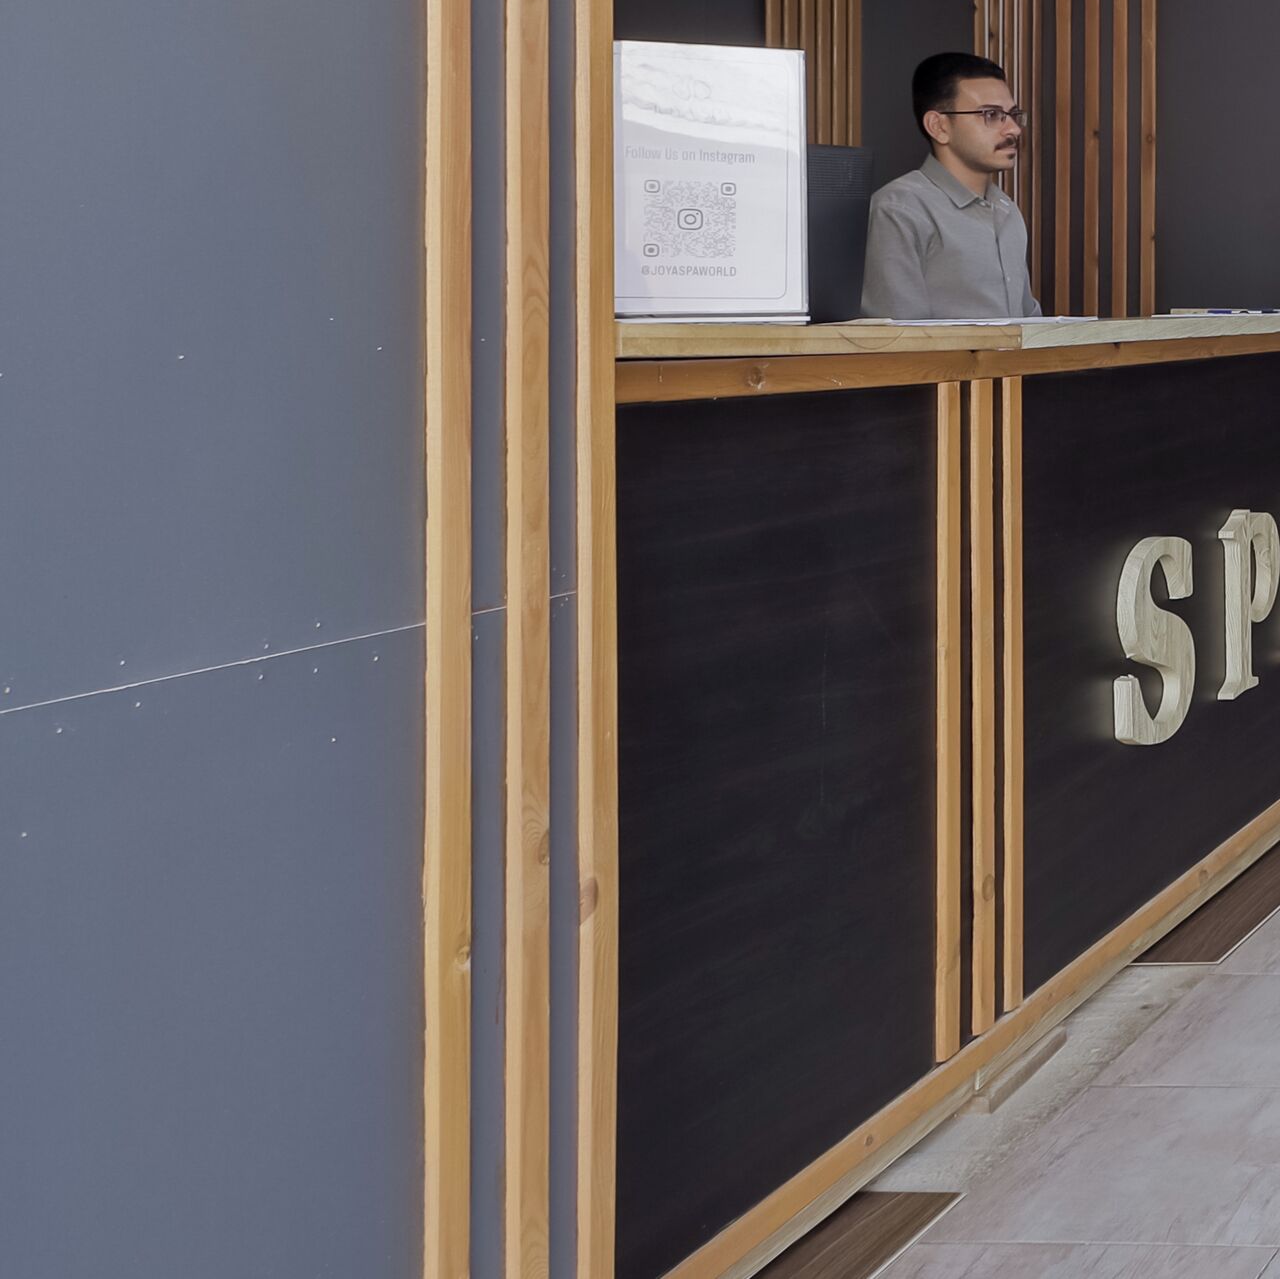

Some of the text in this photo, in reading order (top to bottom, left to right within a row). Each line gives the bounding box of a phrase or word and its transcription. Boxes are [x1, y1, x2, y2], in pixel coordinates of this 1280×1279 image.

[625, 145, 756, 165] Follow Us on Instagram
[641, 264, 737, 277] @JOYASPAWORLD
